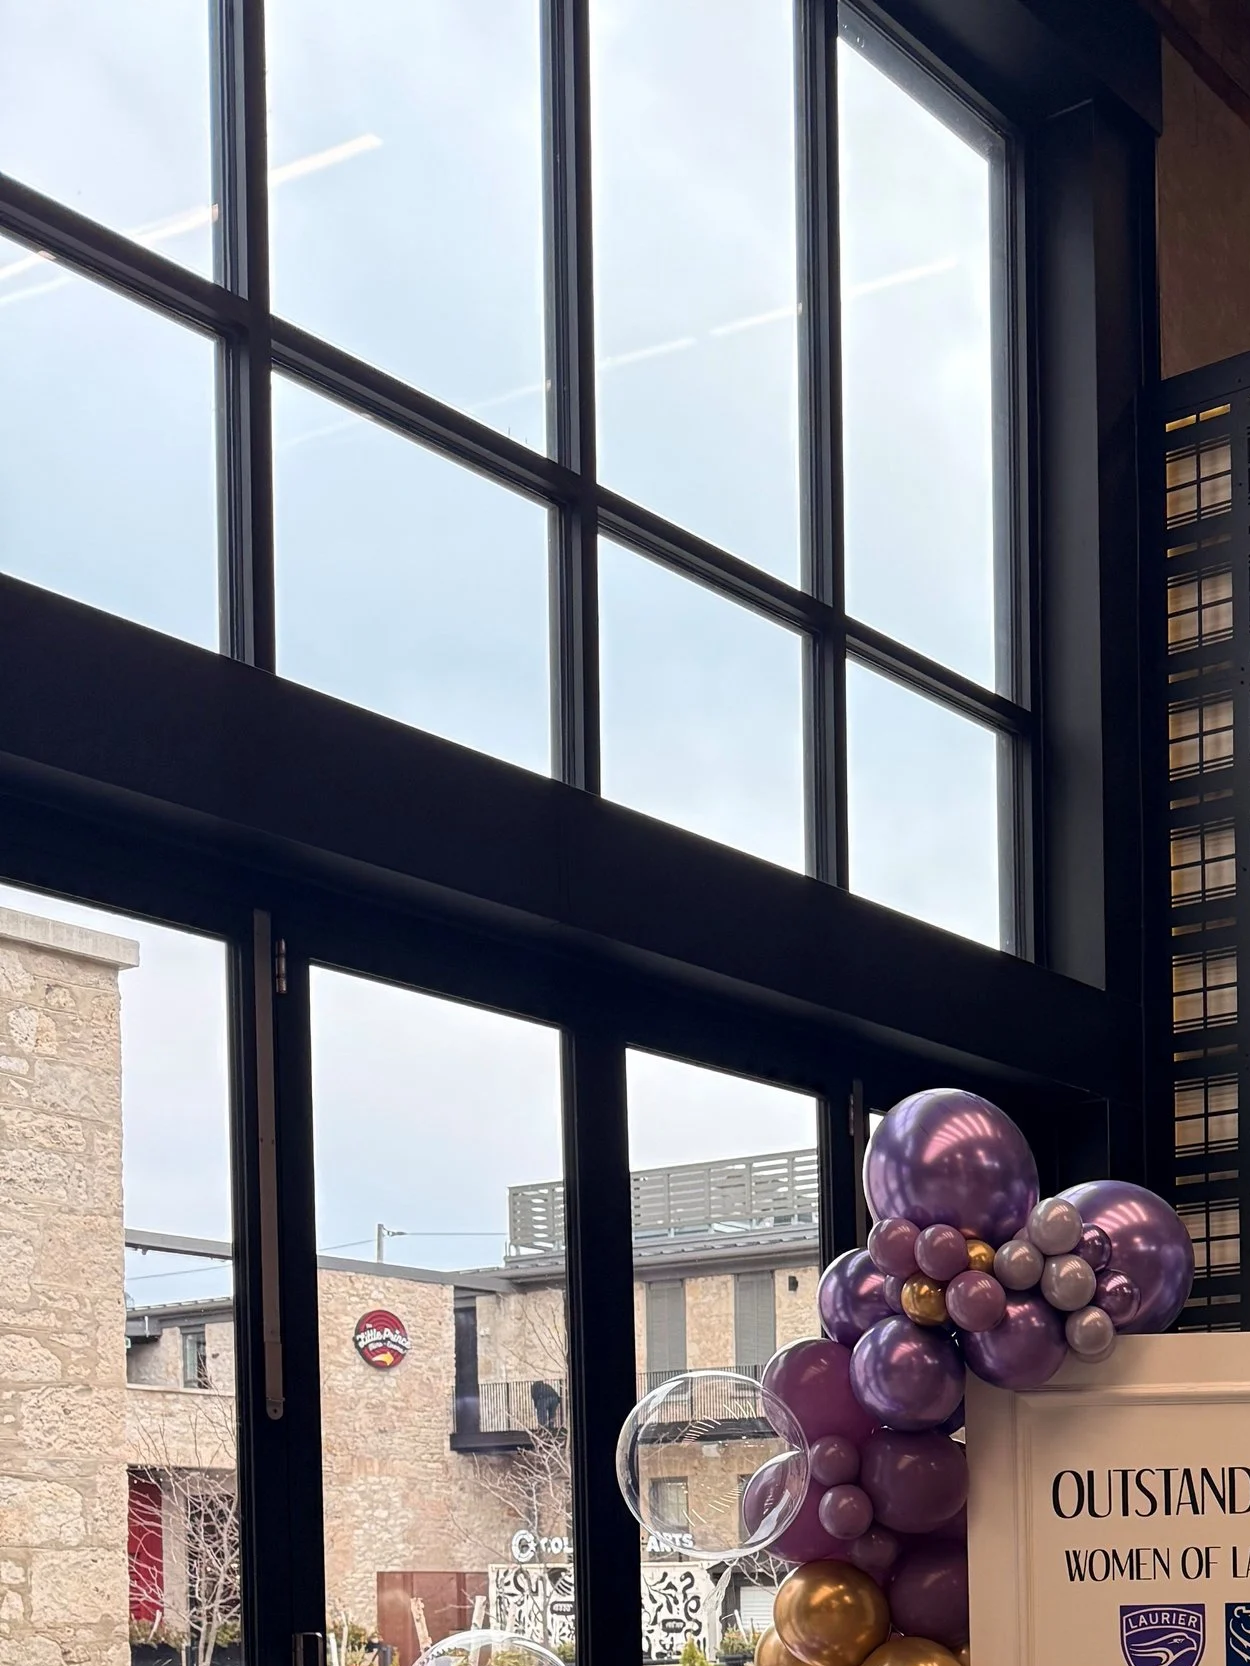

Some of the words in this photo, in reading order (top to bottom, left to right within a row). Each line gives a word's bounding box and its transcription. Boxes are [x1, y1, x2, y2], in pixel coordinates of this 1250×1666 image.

[1064, 1547, 1171, 1582] WOMEN
[1181, 1546, 1221, 1580] OF
[1128, 1612, 1198, 1629] LAURIER
